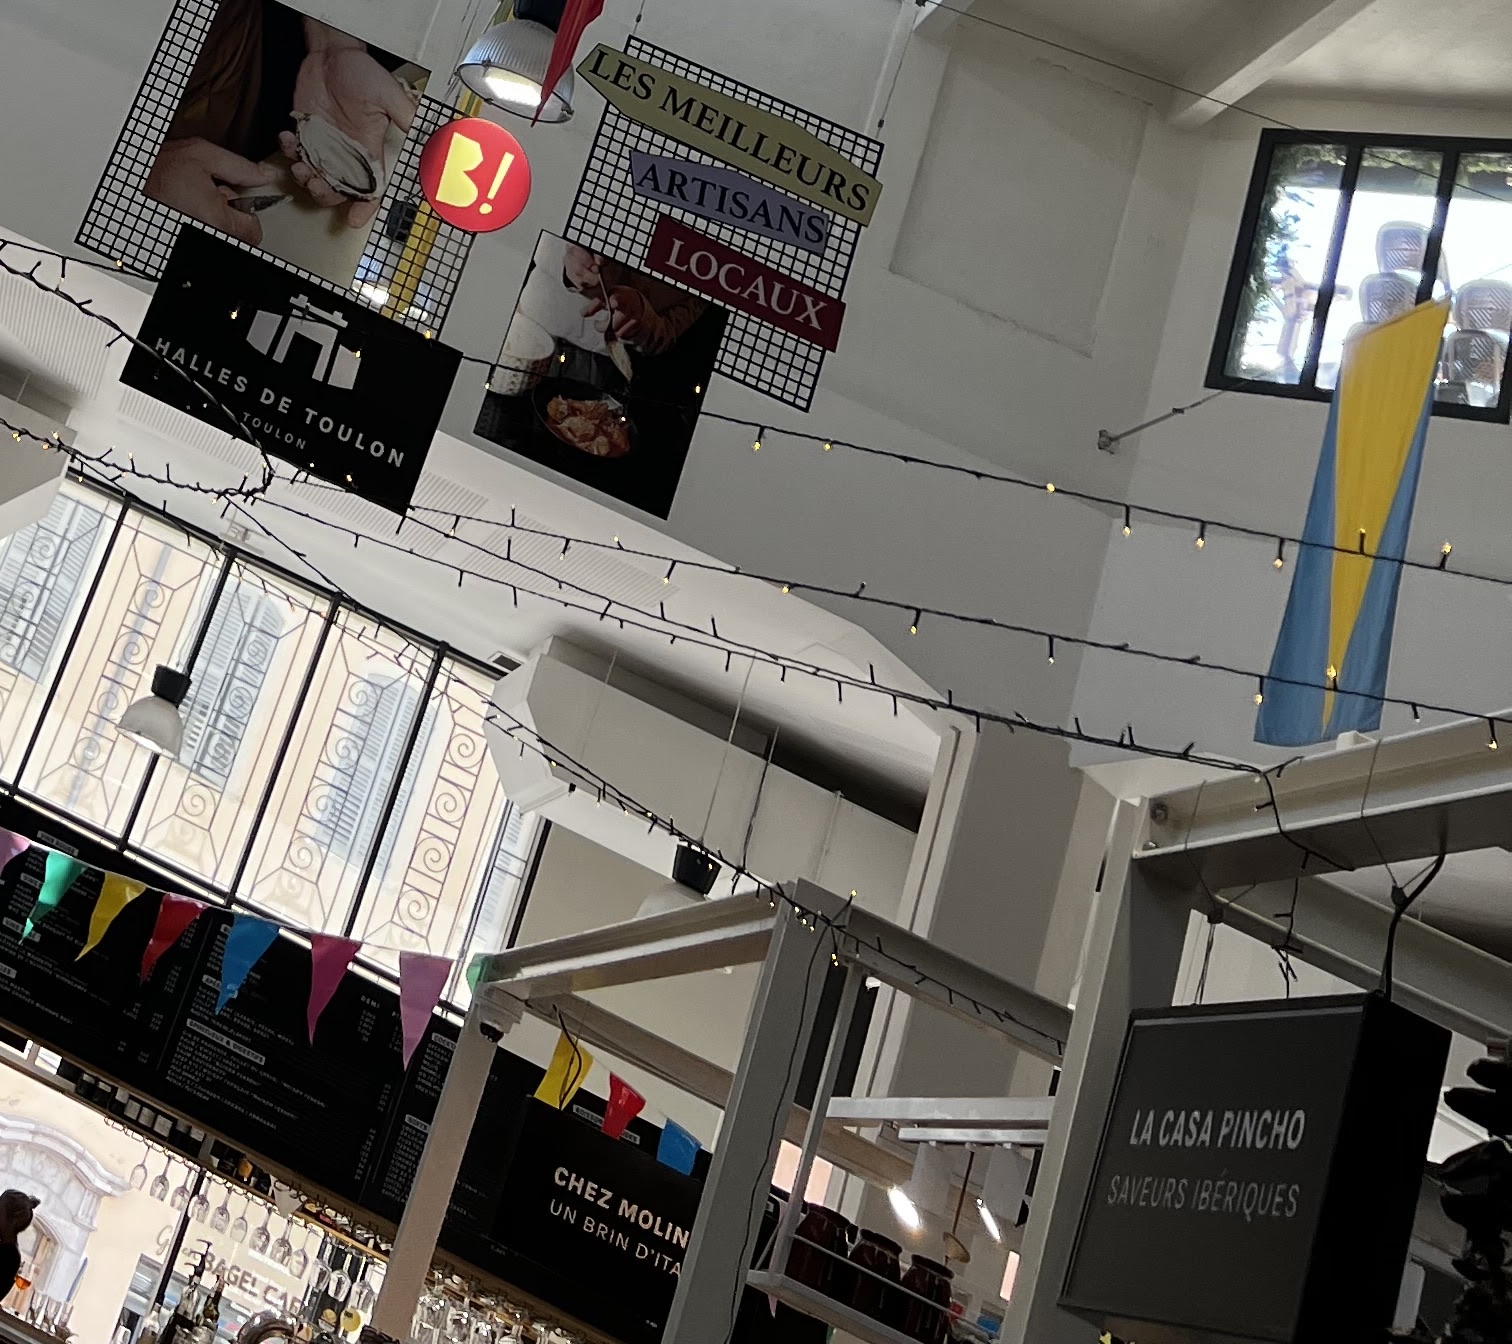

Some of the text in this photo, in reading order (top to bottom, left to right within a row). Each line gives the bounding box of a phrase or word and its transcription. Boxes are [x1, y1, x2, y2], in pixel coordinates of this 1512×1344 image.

[589, 49, 870, 212] LES MEILLEURS
[638, 164, 825, 243] ARTISANS
[665, 238, 828, 331] LOCAUX
[154, 338, 404, 468] HALLES DE TOULON
[242, 412, 307, 450] TOULON
[1130, 1109, 1306, 1150] LA CASA PINCHO
[550, 1199, 577, 1224] UN
[583, 1216, 629, 1250] BRIN
[554, 1167, 689, 1249] CHEZ MOLIN
[1108, 1167, 1300, 1222] SAVEURS IBÉRIQUES
